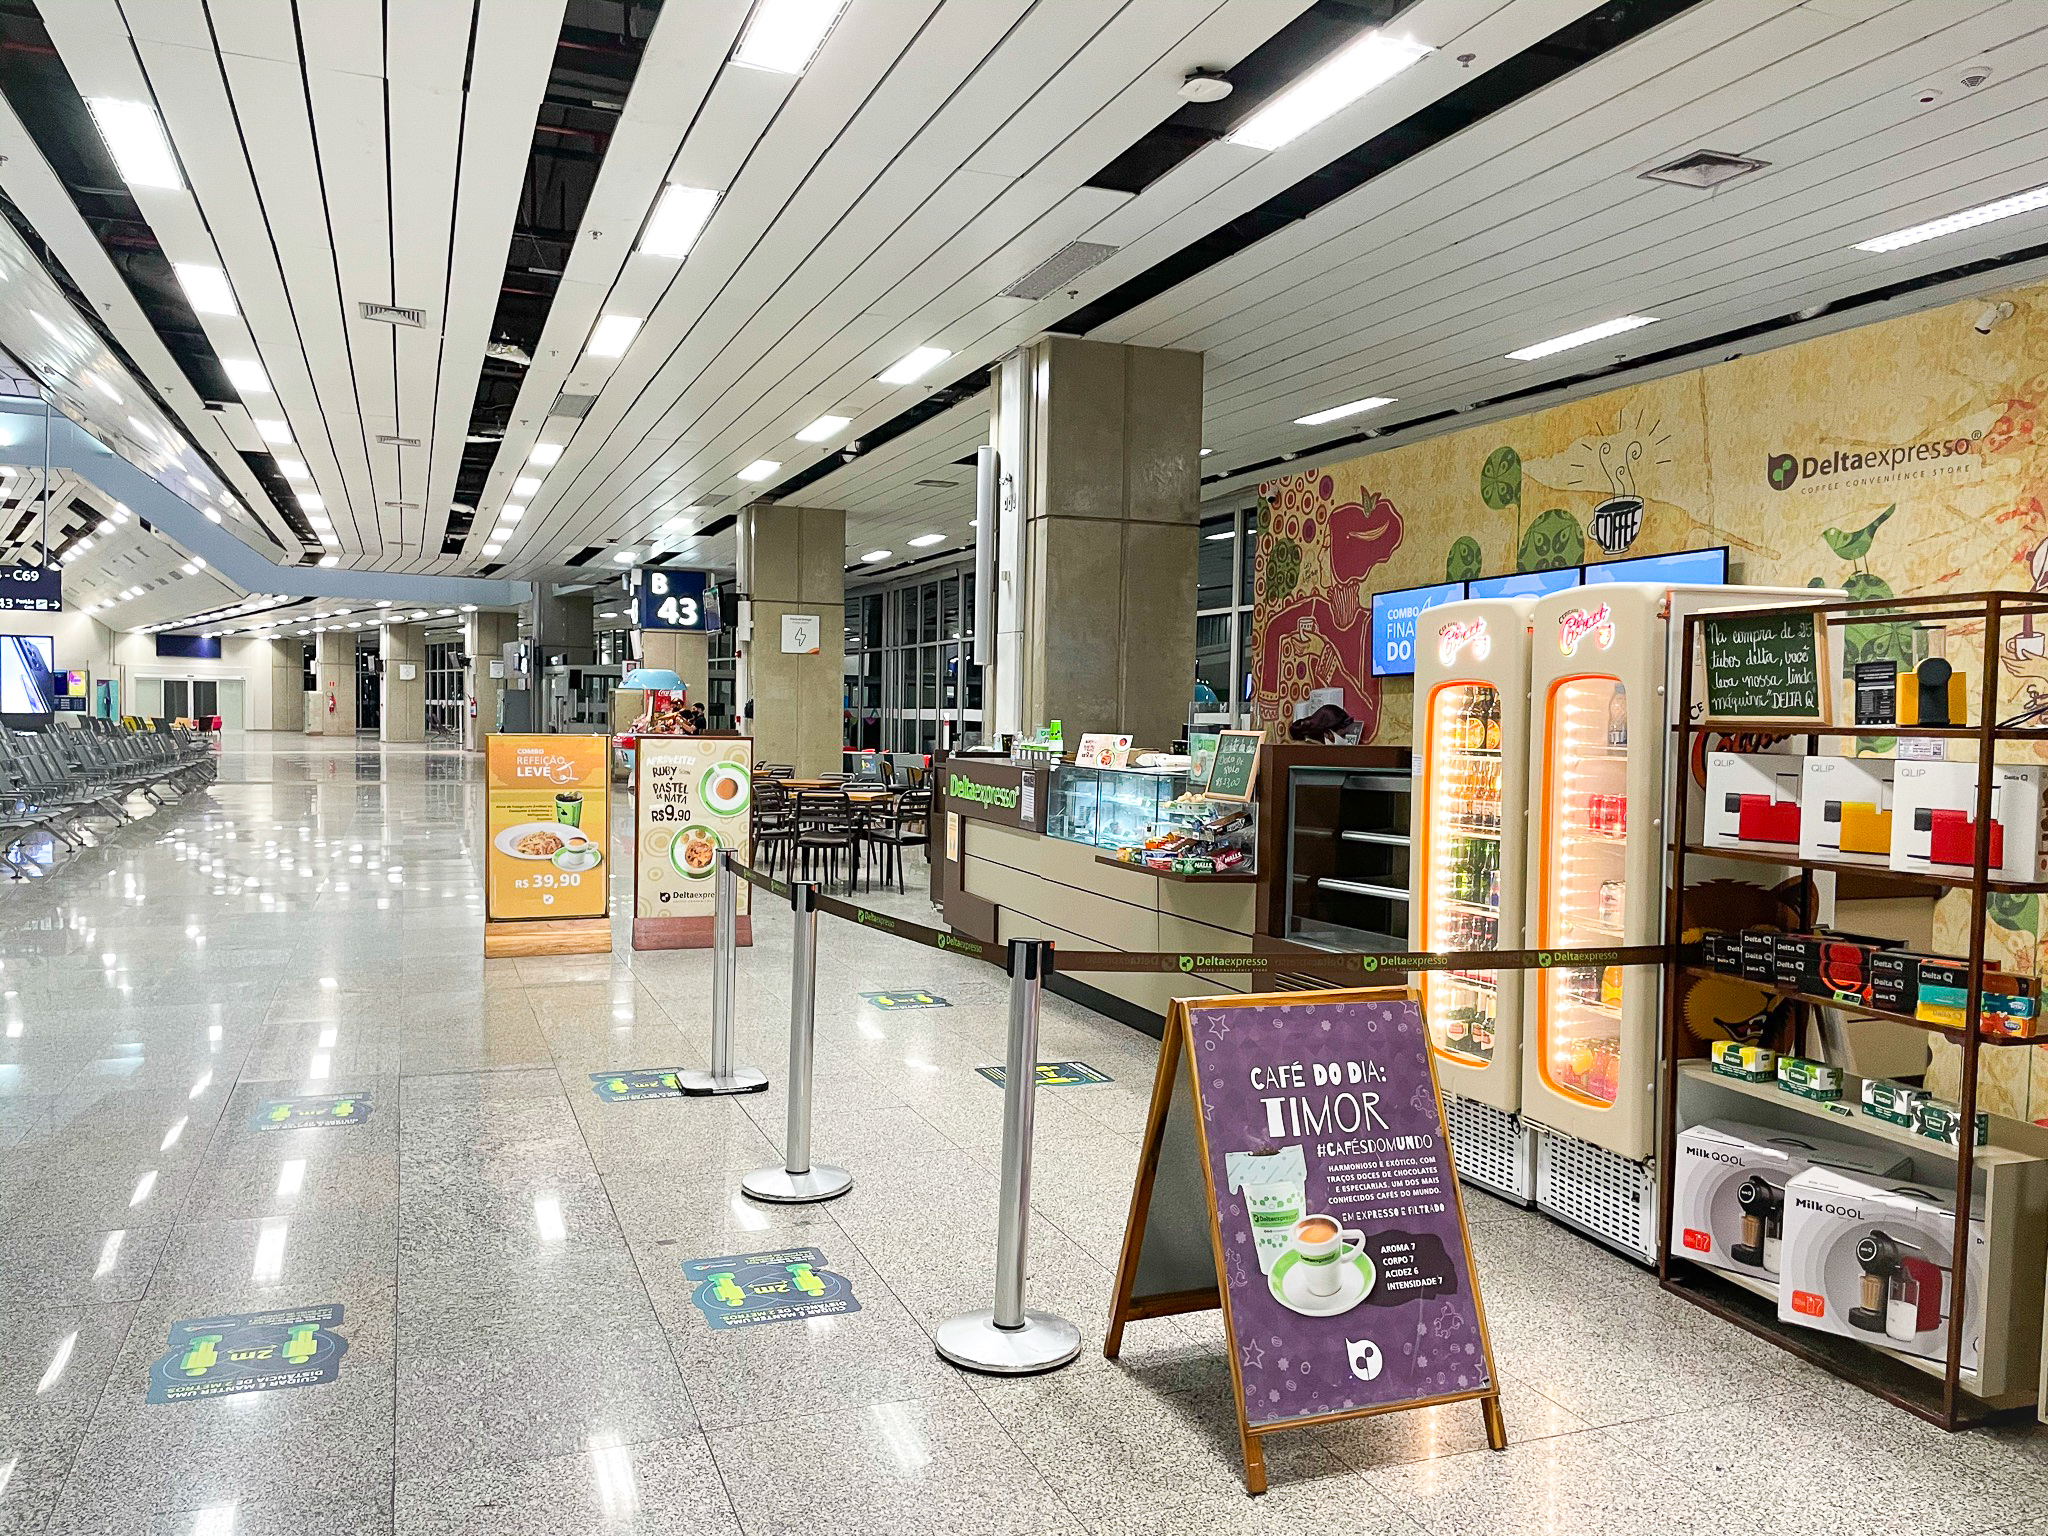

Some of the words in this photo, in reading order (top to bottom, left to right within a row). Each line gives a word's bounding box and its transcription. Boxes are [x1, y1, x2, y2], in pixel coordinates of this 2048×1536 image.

[1801, 482, 1839, 495] COFFEE
[1845, 470, 1925, 488] CONVENIENCE
[1932, 464, 1970, 478] STORE
[13, 570, 39, 581] C69
[651, 573, 668, 594] B
[657, 596, 698, 625] 43
[1387, 607, 1418, 620] COMBO
[1708, 622, 1727, 645] Na
[1732, 629, 1778, 652] compra
[1781, 621, 1796, 639] de
[1710, 650, 1741, 669] tubos
[1784, 645, 1810, 664] você
[1712, 672, 1738, 689] leva
[1742, 675, 1783, 688] nossa
[516, 755, 565, 766] REFEIÇÃO
[1713, 759, 1735, 767] QLIP
[516, 767, 551, 777] LEVE
[652, 766, 677, 777] RUBY
[1811, 764, 1835, 773] QLIP
[1901, 768, 1926, 778] QLIP
[652, 782, 689, 794] PASTEL
[664, 793, 687, 804] NATA
[1224, 852, 1243, 863] HALLS
[532, 873, 581, 888] 39,90
[946, 935, 983, 953] Deltaexpresso
[1744, 935, 1762, 943] Delta
[1763, 935, 1772, 945] Q
[1777, 943, 1795, 951] Delta
[1796, 944, 1805, 954] Q
[1196, 955, 1268, 968] Deltaexpresso
[1380, 955, 1448, 968] Deltaexpresso
[1554, 951, 1618, 963] Deltaexpresso
[1745, 952, 1762, 960] Delta
[1763, 952, 1773, 962] Q
[1776, 961, 1794, 969] Delta
[1795, 961, 1804, 971] Q
[1873, 960, 1892, 969] Delta
[1893, 961, 1903, 971] Q
[1874, 978, 1893, 987] Delta
[1893, 979, 1904, 990] Q
[1921, 972, 1941, 980] Delta
[1943, 972, 1953, 984] Q
[1250, 1060, 1305, 1090] CAFÉ
[1312, 1062, 1342, 1086] DO
[1346, 1060, 1387, 1084] DIA:
[1260, 1091, 1389, 1138] TIMOR
[1317, 1134, 1433, 1157] #CAFÉSDOMUNDO
[1686, 1146, 1709, 1159] Milk
[1712, 1152, 1745, 1167] QOOL
[1328, 1161, 1377, 1172] HARMONIOSO
[1386, 1158, 1418, 1167] EXÓTICO,
[1419, 1156, 1436, 1164] COM
[1327, 1174, 1355, 1183] TRAÇOS
[1356, 1172, 1380, 1180] DOCES
[1382, 1170, 1392, 1178] DE
[1393, 1166, 1438, 1177] CHOCOLATES
[1342, 1182, 1390, 1193] ESPECIARIAS.
[1391, 1180, 1403, 1188] UM
[1405, 1178, 1420, 1186] DOS
[1421, 1176, 1439, 1185] MAIS
[1328, 1193, 1374, 1204] CONHECIDOS
[1376, 1190, 1398, 1200] CAFÉS
[1400, 1189, 1411, 1197] DO
[1412, 1187, 1441, 1196] MUNDO.
[1342, 1212, 1355, 1222] EM
[1356, 1207, 1399, 1220] EXPRESSO
[1400, 1207, 1406, 1216] E
[1408, 1203, 1445, 1215] FILTRADO
[1796, 1198, 1823, 1211] Milk
[1826, 1204, 1865, 1220] QOOL
[1381, 1243, 1410, 1254] AROMA
[1410, 1242, 1416, 1250] 7
[1382, 1257, 1408, 1266] CORPO
[1409, 1255, 1414, 1263] 7
[1385, 1268, 1412, 1278] ACIDEZ
[1414, 1267, 1419, 1275] 6
[754, 1283, 790, 1294] 2m
[1387, 1278, 1437, 1291] INTENSIDADE
[1437, 1276, 1443, 1284] 7
[777, 1307, 791, 1315] DE
[807, 1305, 846, 1315] CUIDAR
[725, 1317, 751, 1326] UMA
[753, 1311, 797, 1322] MANTER
[230, 1349, 273, 1361] 2m
[269, 1376, 318, 1387] CUIDAR
[167, 1391, 197, 1399] UMA
[200, 1383, 256, 1395] MANTER
